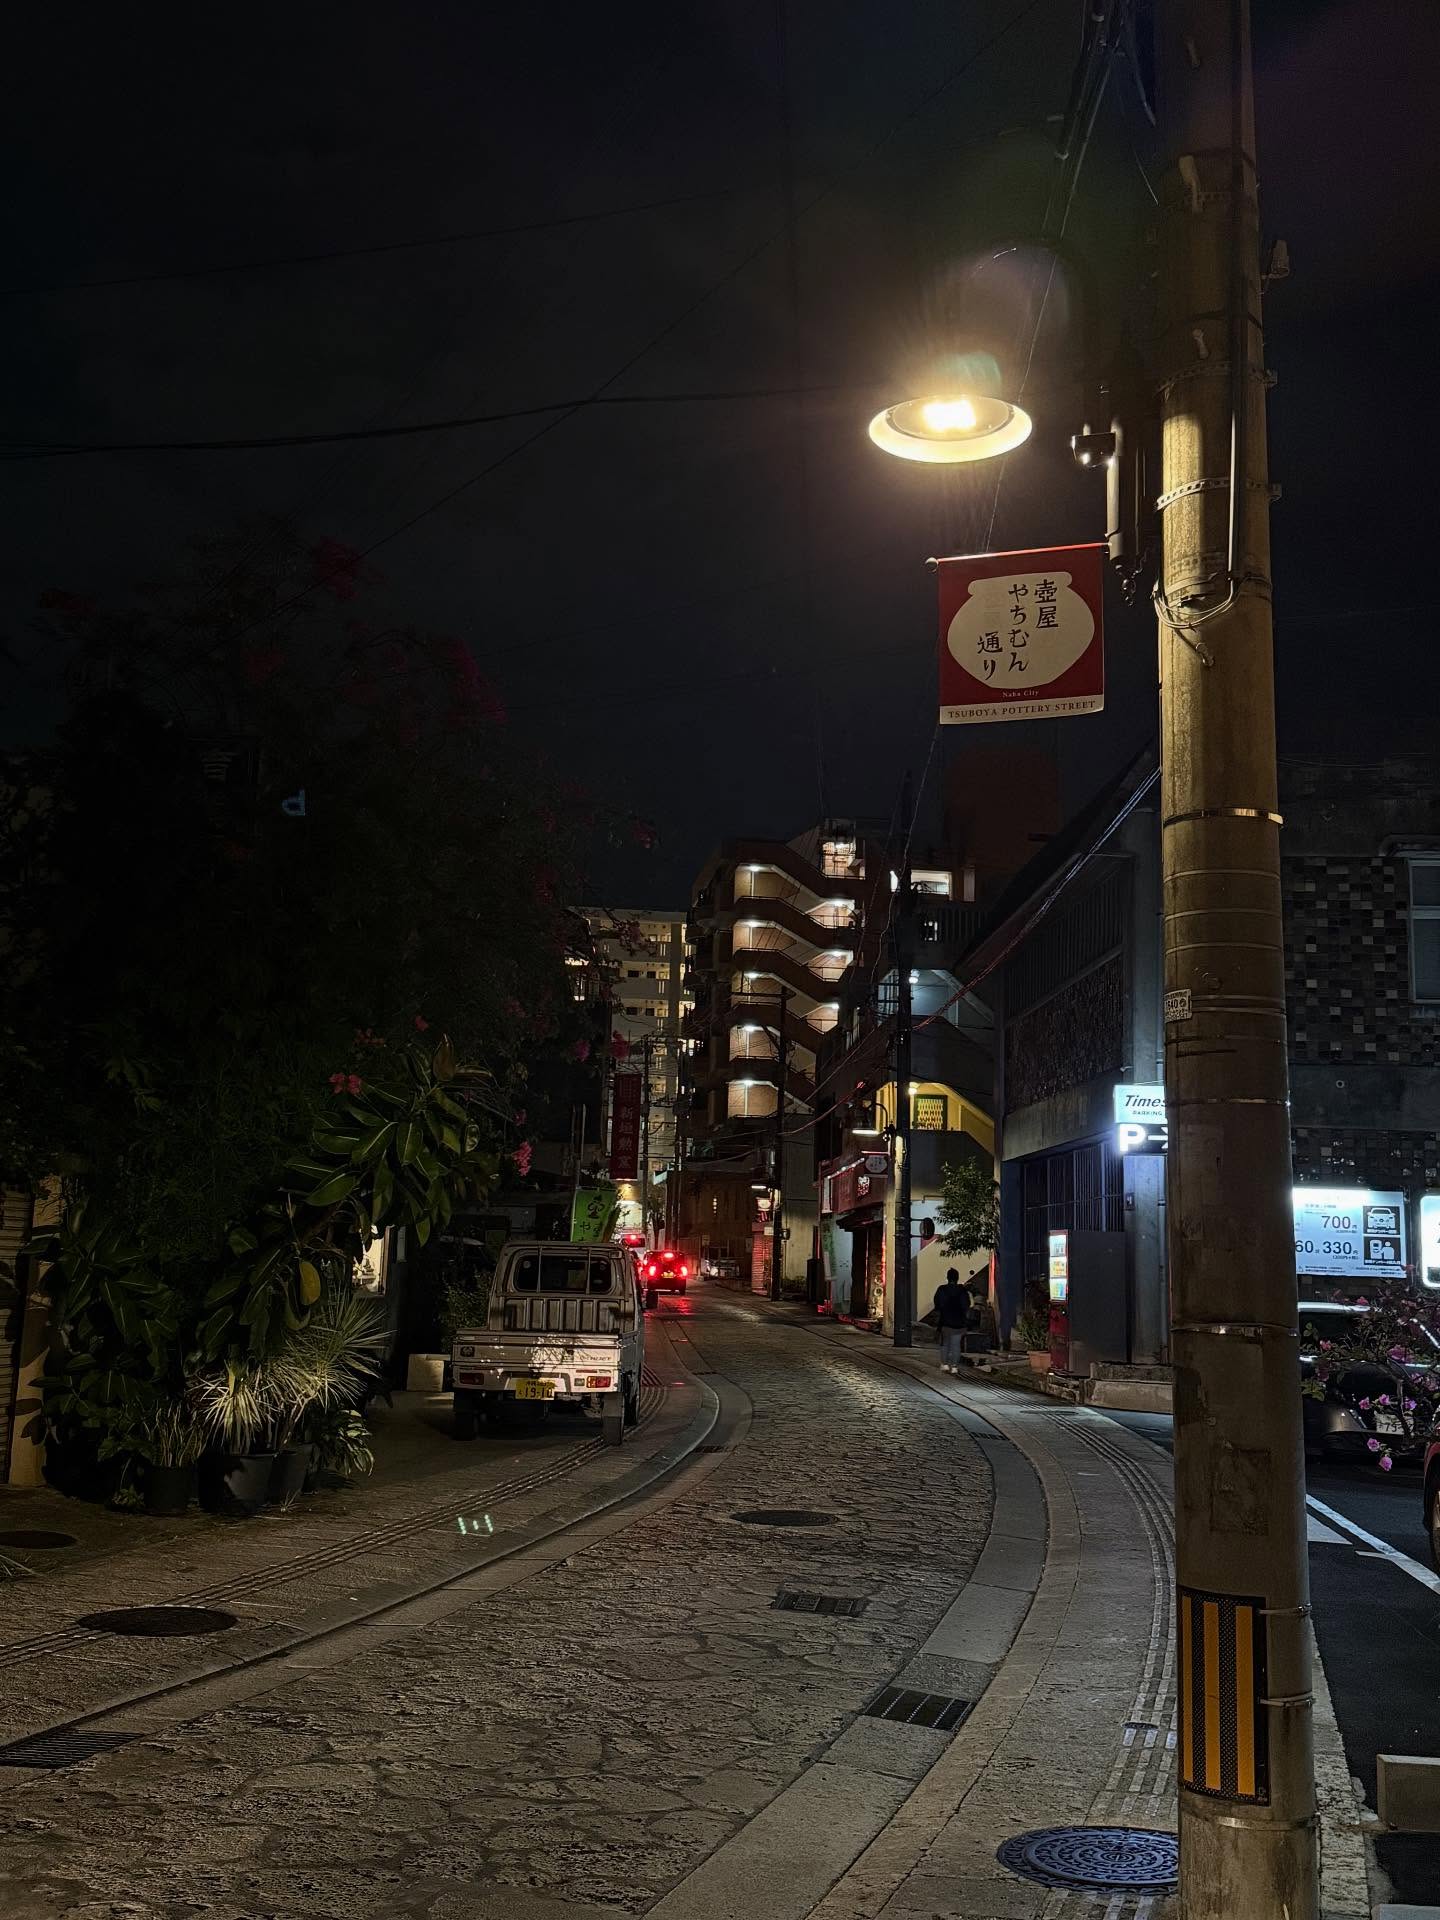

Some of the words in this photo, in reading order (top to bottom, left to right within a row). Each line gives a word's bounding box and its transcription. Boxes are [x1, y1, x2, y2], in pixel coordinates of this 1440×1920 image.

[1034, 579, 1059, 629] 壺屋
[1008, 583, 1029, 672] やちむん
[977, 631, 1002, 680] 通り
[948, 708, 997, 718] TSUBOYA
[1002, 704, 1051, 715] POTTERY
[1055, 700, 1096, 711] STREET
[1002, 690, 1021, 698] Naha
[1023, 689, 1040, 698] City
[1119, 1123, 1146, 1152] P
